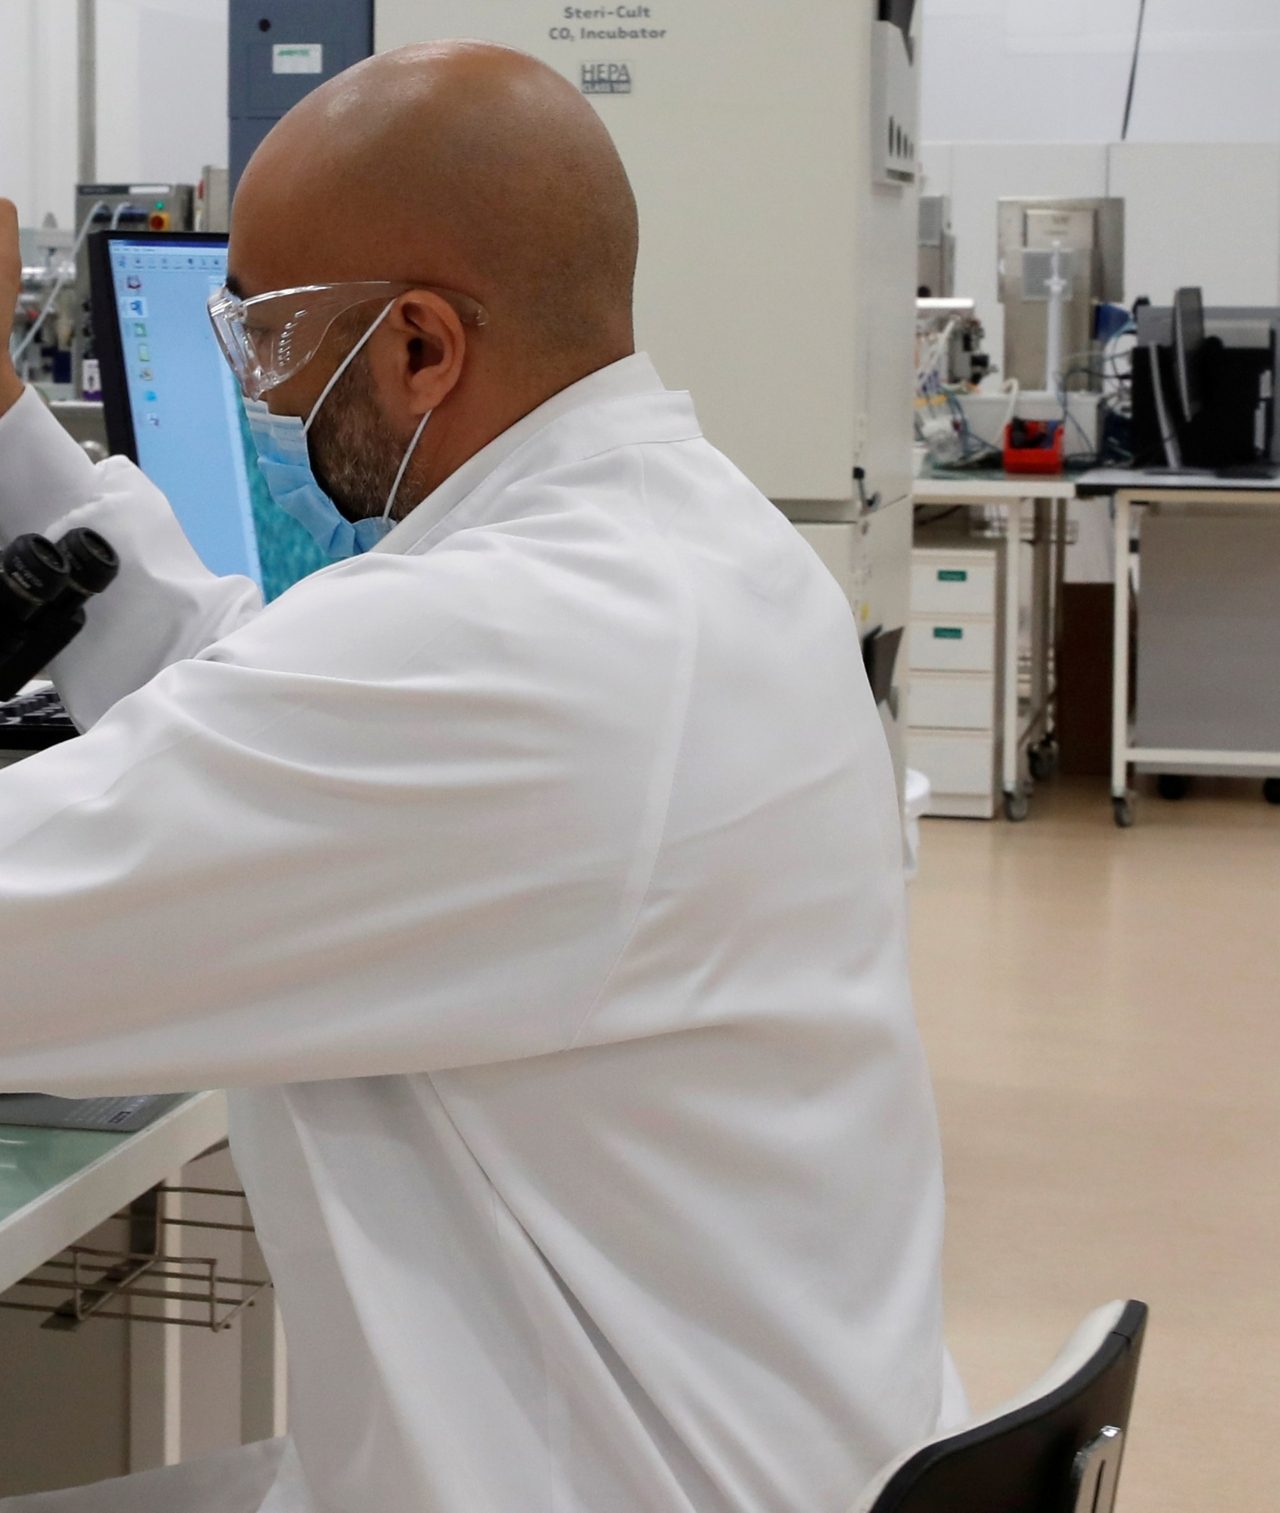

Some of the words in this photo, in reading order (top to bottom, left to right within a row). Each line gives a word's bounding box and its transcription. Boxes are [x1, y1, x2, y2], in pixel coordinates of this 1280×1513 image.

[564, 5, 650, 19] Steri-Cult
[580, 26, 667, 39] Incubator
[581, 63, 631, 81] HEPA
